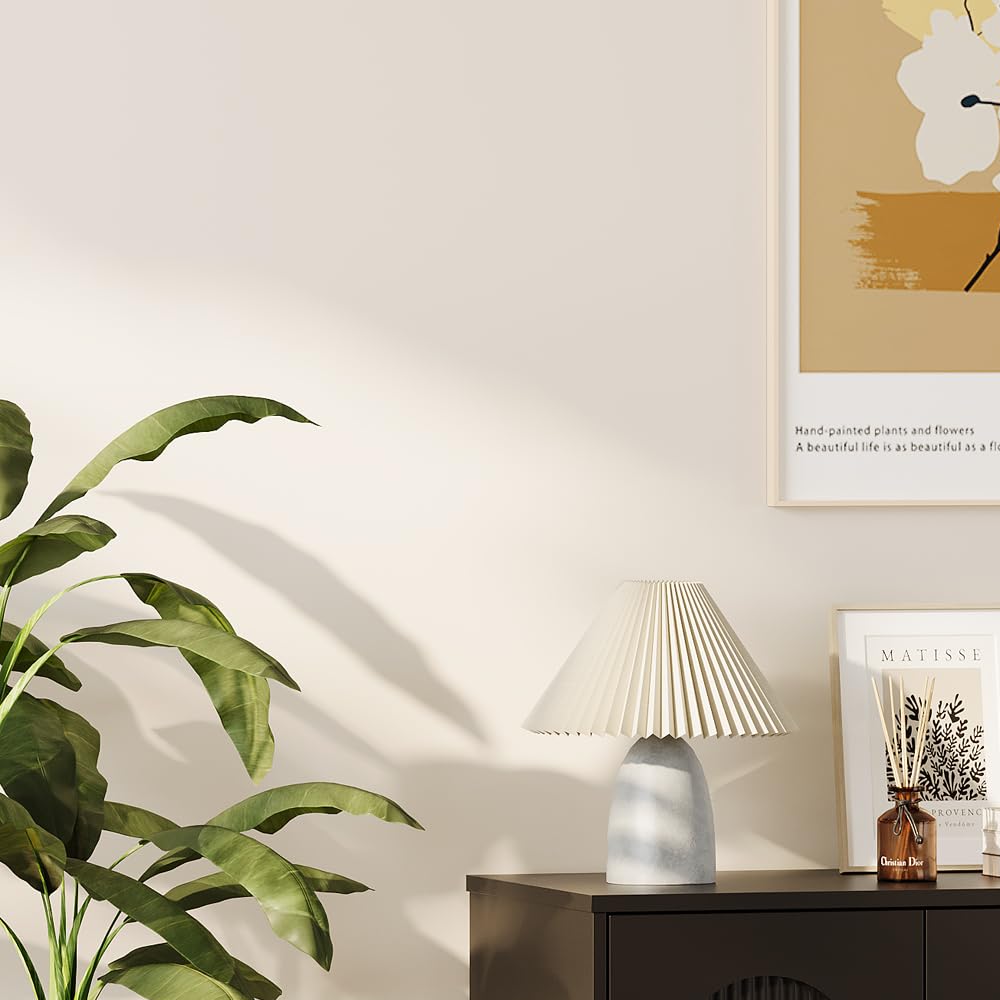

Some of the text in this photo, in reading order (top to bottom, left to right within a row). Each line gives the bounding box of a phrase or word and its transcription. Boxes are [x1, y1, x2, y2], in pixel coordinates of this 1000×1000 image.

[795, 425, 975, 437] Hand-painted plants and flowers
[796, 442, 803, 452] A
[807, 442, 858, 452] beautiful
[862, 442, 880, 452] life
[883, 442, 892, 452] is
[895, 444, 907, 452] as
[911, 442, 962, 452] beautiful
[965, 444, 976, 452] as
[980, 444, 986, 452] a
[881, 648, 982, 662] MATISSE
[931, 808, 983, 817] PROVENC
[908, 856, 925, 867] Dior
